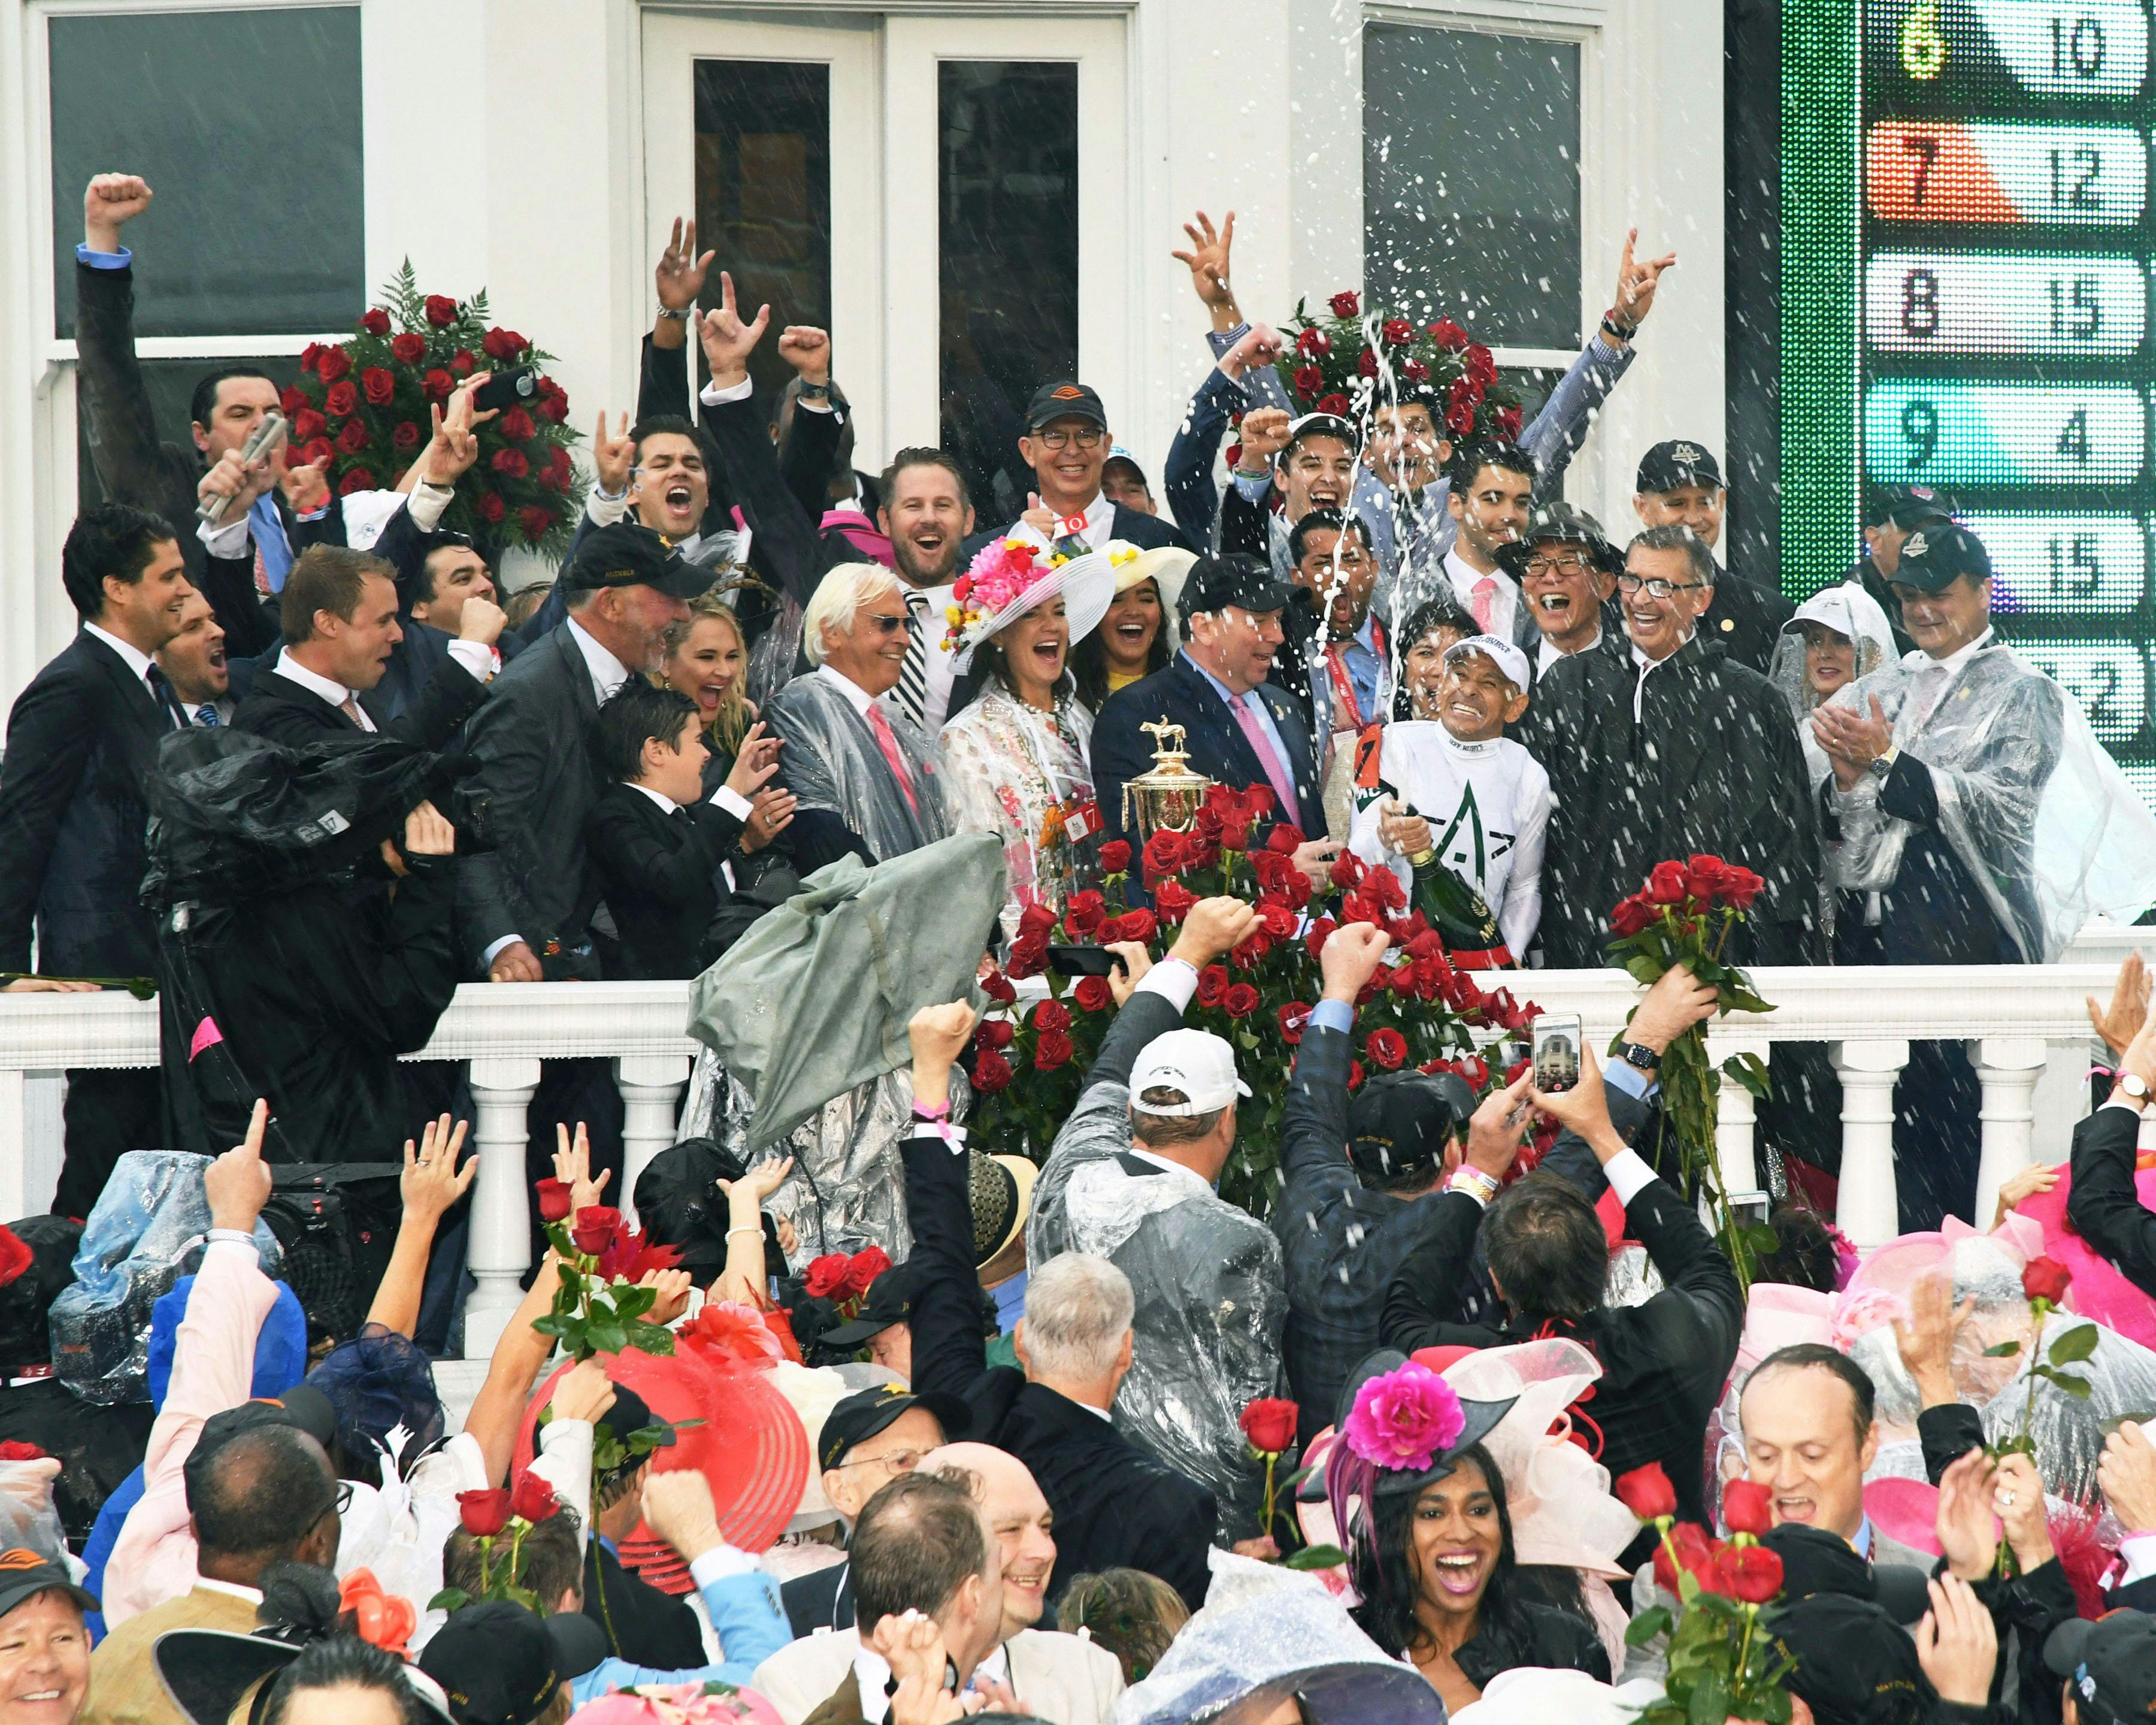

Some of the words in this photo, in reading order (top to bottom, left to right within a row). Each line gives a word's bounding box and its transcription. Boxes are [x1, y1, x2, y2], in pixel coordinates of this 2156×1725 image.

[1899, 0, 1945, 79] 6
[2053, 15, 2104, 77] 10
[1901, 137, 1940, 207] 7
[2051, 145, 2100, 208] 12
[1902, 268, 1939, 337] 8
[2051, 273, 2102, 339] 15
[1901, 400, 1939, 468] 9
[2056, 405, 2091, 465] 4
[2051, 536, 2100, 597] 15
[1354, 740, 1376, 782] 7
